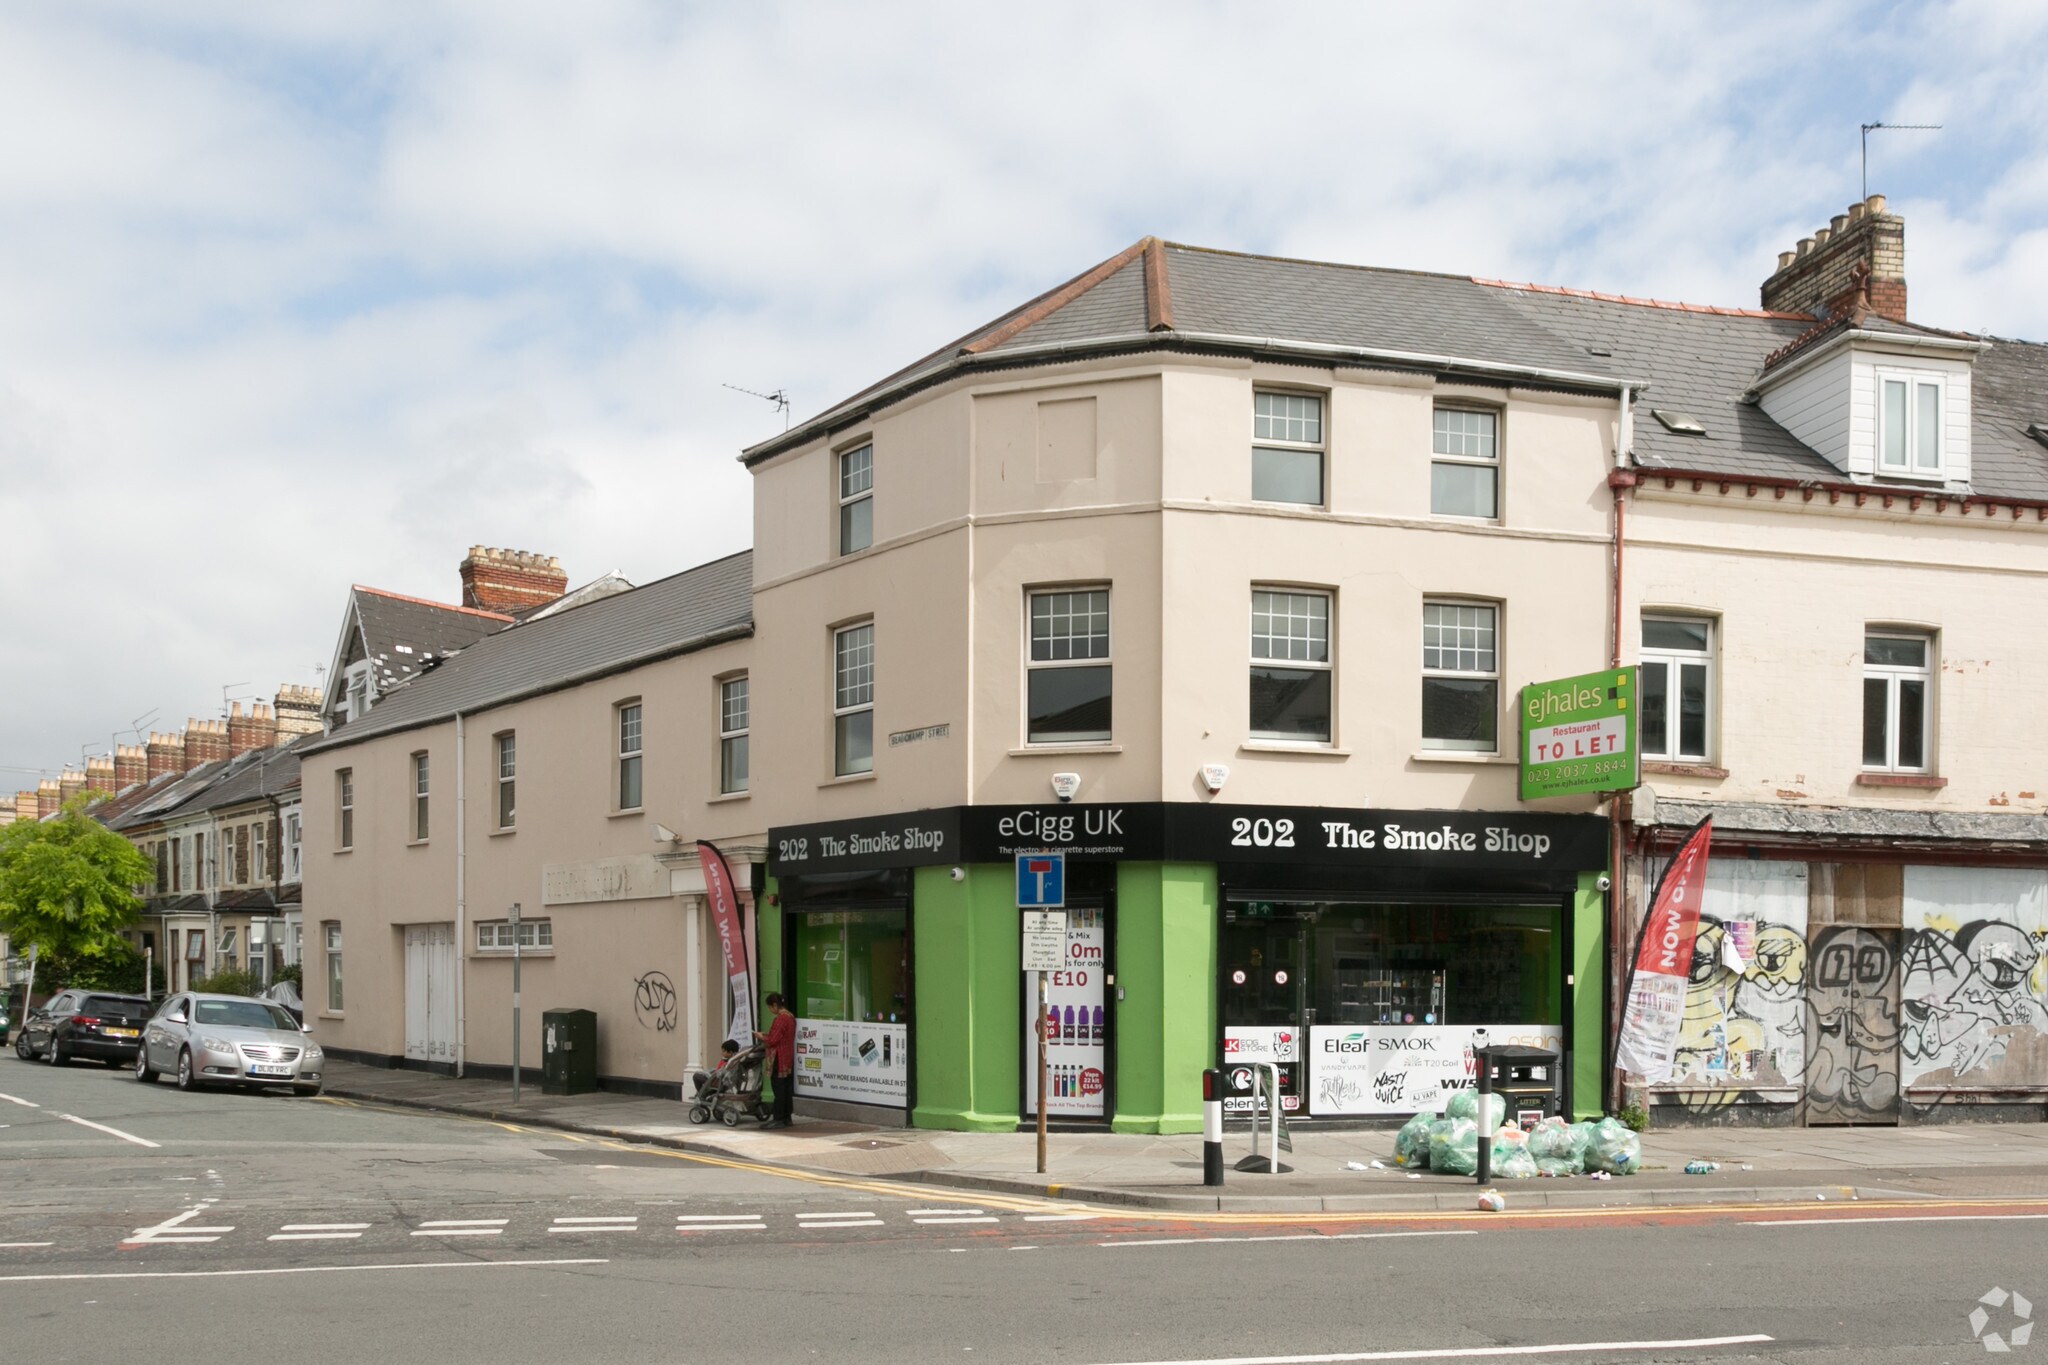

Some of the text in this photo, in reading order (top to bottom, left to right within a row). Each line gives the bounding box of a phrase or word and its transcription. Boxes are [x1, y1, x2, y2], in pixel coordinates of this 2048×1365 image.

[1528, 684, 1602, 723] ejhales
[1552, 722, 1601, 737] Restaurant
[1537, 734, 1617, 761] TO LET
[1528, 759, 1627, 783] 029 2037 8844
[1541, 775, 1611, 790] www.ejhales.co.uk
[998, 809, 1124, 842] eCigg UK
[779, 827, 944, 862] 202 The Smoke Shop
[1231, 817, 1550, 858] 202 The Smoke Shop
[1084, 845, 1124, 854] superstore
[1068, 932, 1091, 940] & Mix
[1660, 909, 1682, 968] NOW
[1087, 960, 1104, 968] only
[1052, 971, 1088, 987] £10
[1324, 1038, 1437, 1053] Eleaf SMOK
[849, 1076, 869, 1084] BRANDS
[869, 1078, 894, 1086] AVAILABLE
[1374, 1071, 1408, 1088] NASTY
[1422, 1091, 1438, 1099] VAPE
